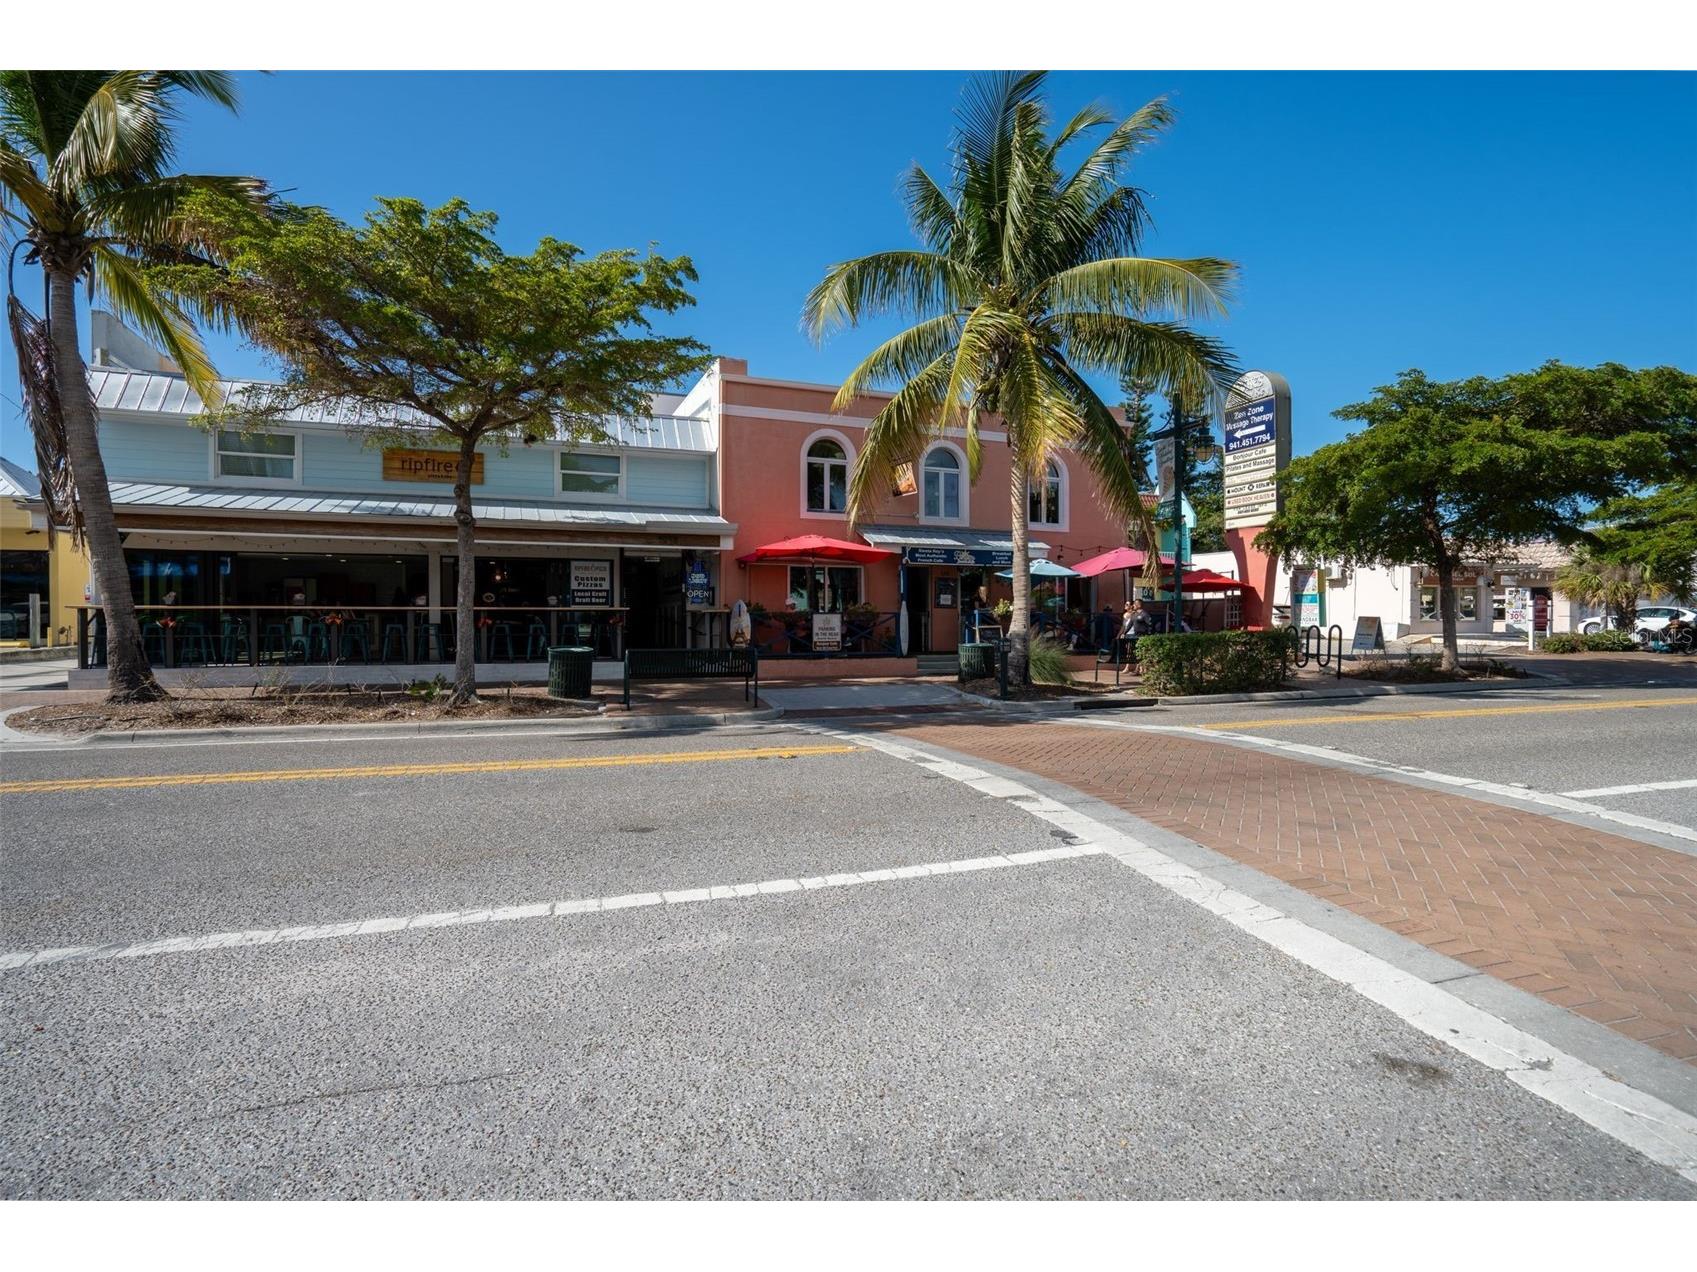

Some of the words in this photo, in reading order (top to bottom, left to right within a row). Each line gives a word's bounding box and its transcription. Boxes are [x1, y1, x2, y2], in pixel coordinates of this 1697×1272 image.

[1247, 405, 1264, 416] Zone
[1250, 412, 1274, 424] Therapy
[1228, 432, 1271, 450] 941.451.7794
[1232, 451, 1253, 461] Bonjour
[401, 457, 453, 474] ripfire
[1252, 458, 1275, 467] Massage
[687, 590, 709, 598] OPEN
